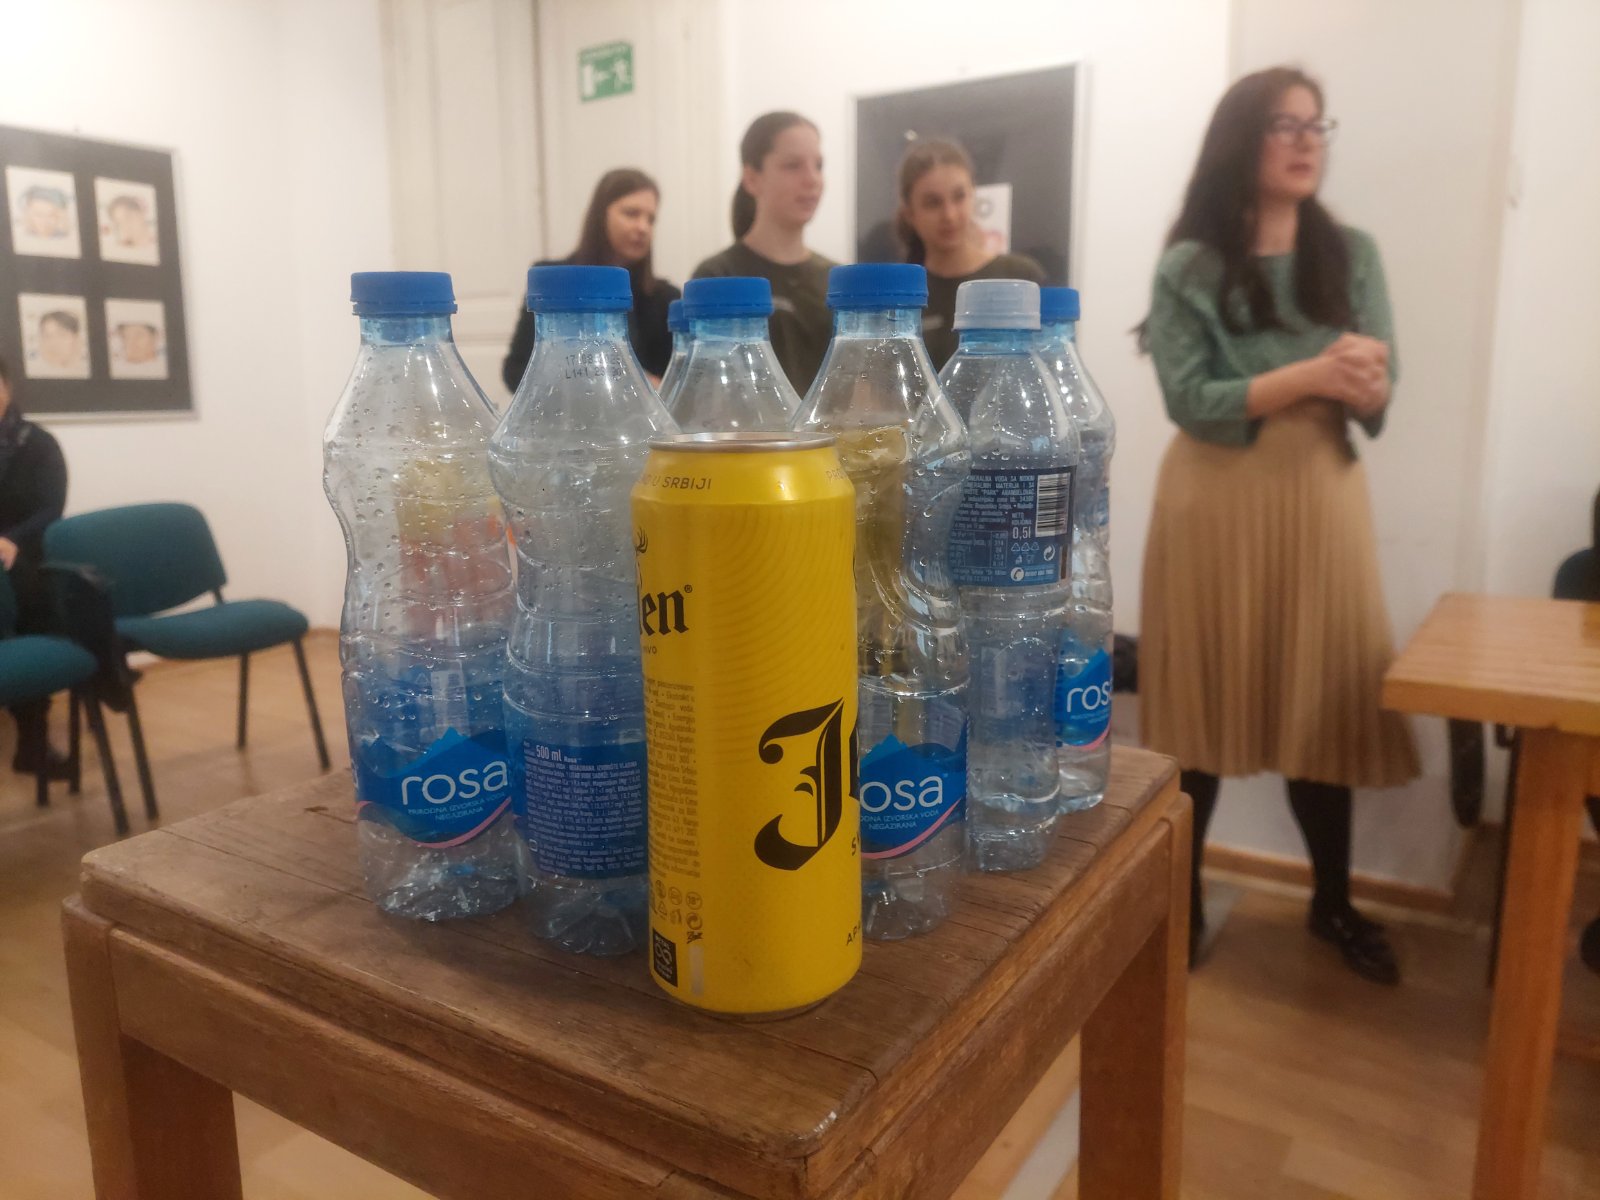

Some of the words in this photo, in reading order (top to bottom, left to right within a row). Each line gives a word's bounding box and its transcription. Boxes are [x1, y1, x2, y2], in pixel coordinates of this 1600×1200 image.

[662, 476, 712, 490] SRBIJI
[640, 590, 689, 636] en
[1067, 681, 1111, 713] ros
[535, 744, 549, 760] 500
[551, 749, 562, 761] ml
[401, 760, 508, 806] rosa
[860, 775, 943, 813] osa
[408, 807, 447, 816] PRIRODNA
[883, 813, 918, 822] IZVORSKA
[921, 810, 940, 818] VODA
[869, 821, 917, 830] NEGAZIRANA
